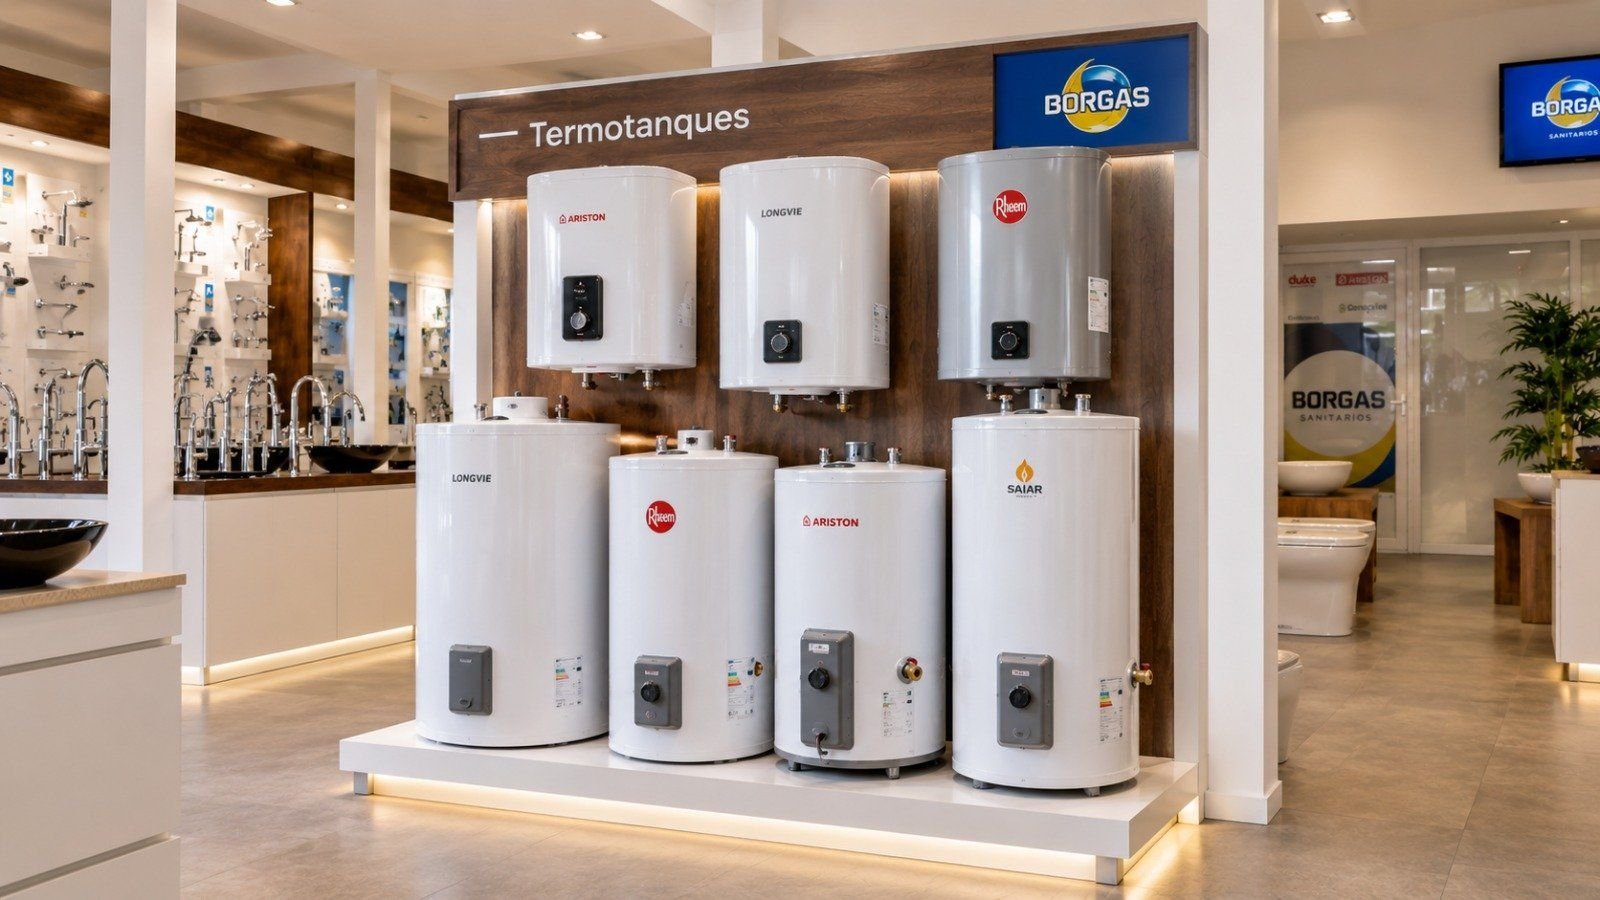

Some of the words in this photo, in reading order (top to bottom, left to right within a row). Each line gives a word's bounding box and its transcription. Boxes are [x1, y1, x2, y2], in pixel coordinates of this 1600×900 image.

[1044, 86, 1150, 116] BORGAS
[529, 108, 750, 148] Termotanques
[1548, 129, 1599, 140] SANITARIOS
[995, 194, 1027, 218] Rheem
[568, 213, 606, 223] ARISTON
[761, 207, 803, 218] LONGVIE
[1292, 391, 1386, 409] BORGAS
[1300, 413, 1372, 422] SANITARIOS
[452, 474, 492, 483] LONGVIE
[1007, 484, 1043, 495] SAIAR
[648, 505, 675, 528] Rheem
[812, 517, 860, 527] ARISTON
